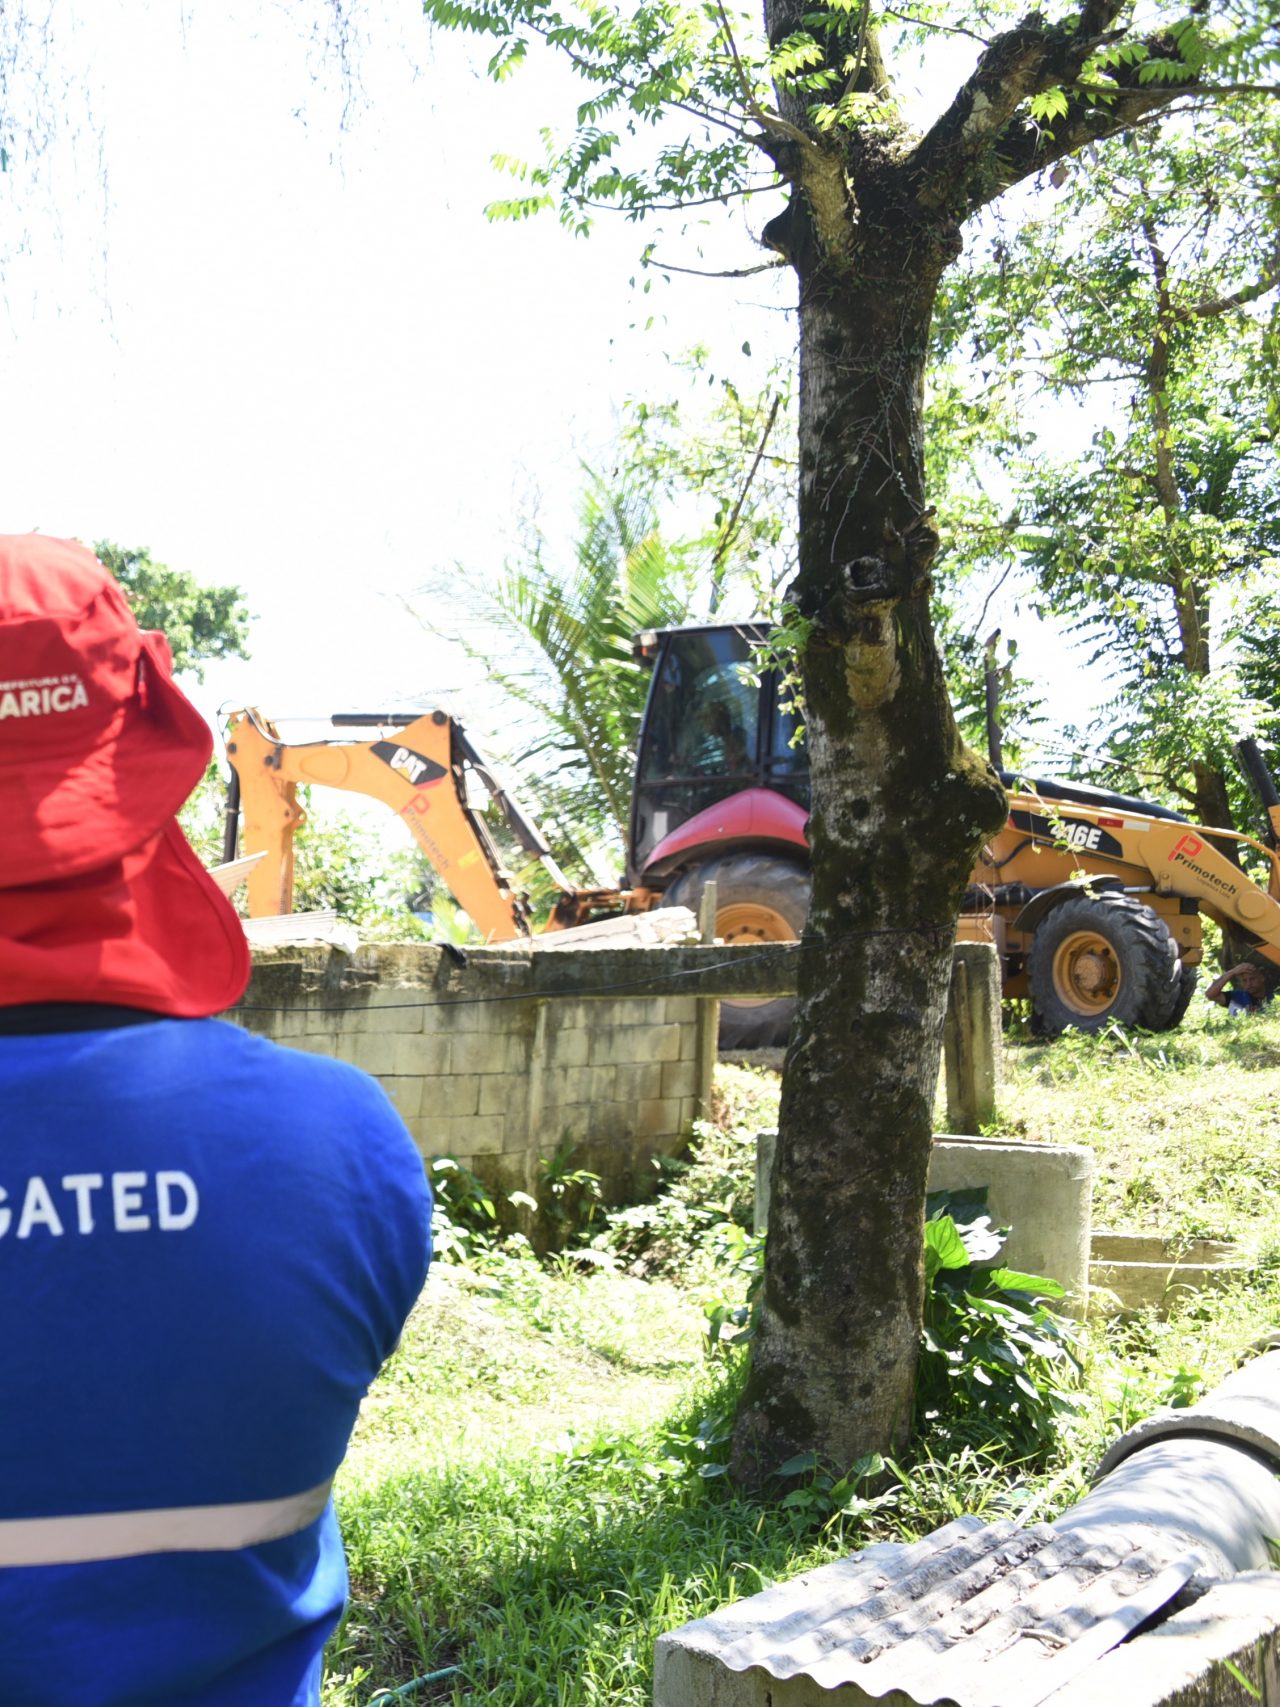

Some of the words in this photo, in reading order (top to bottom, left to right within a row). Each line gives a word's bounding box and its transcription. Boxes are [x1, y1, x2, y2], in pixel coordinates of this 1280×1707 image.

[390, 747, 428, 784] CAT
[1049, 820, 1102, 850] 416E
[1174, 853, 1237, 895] Primotech
